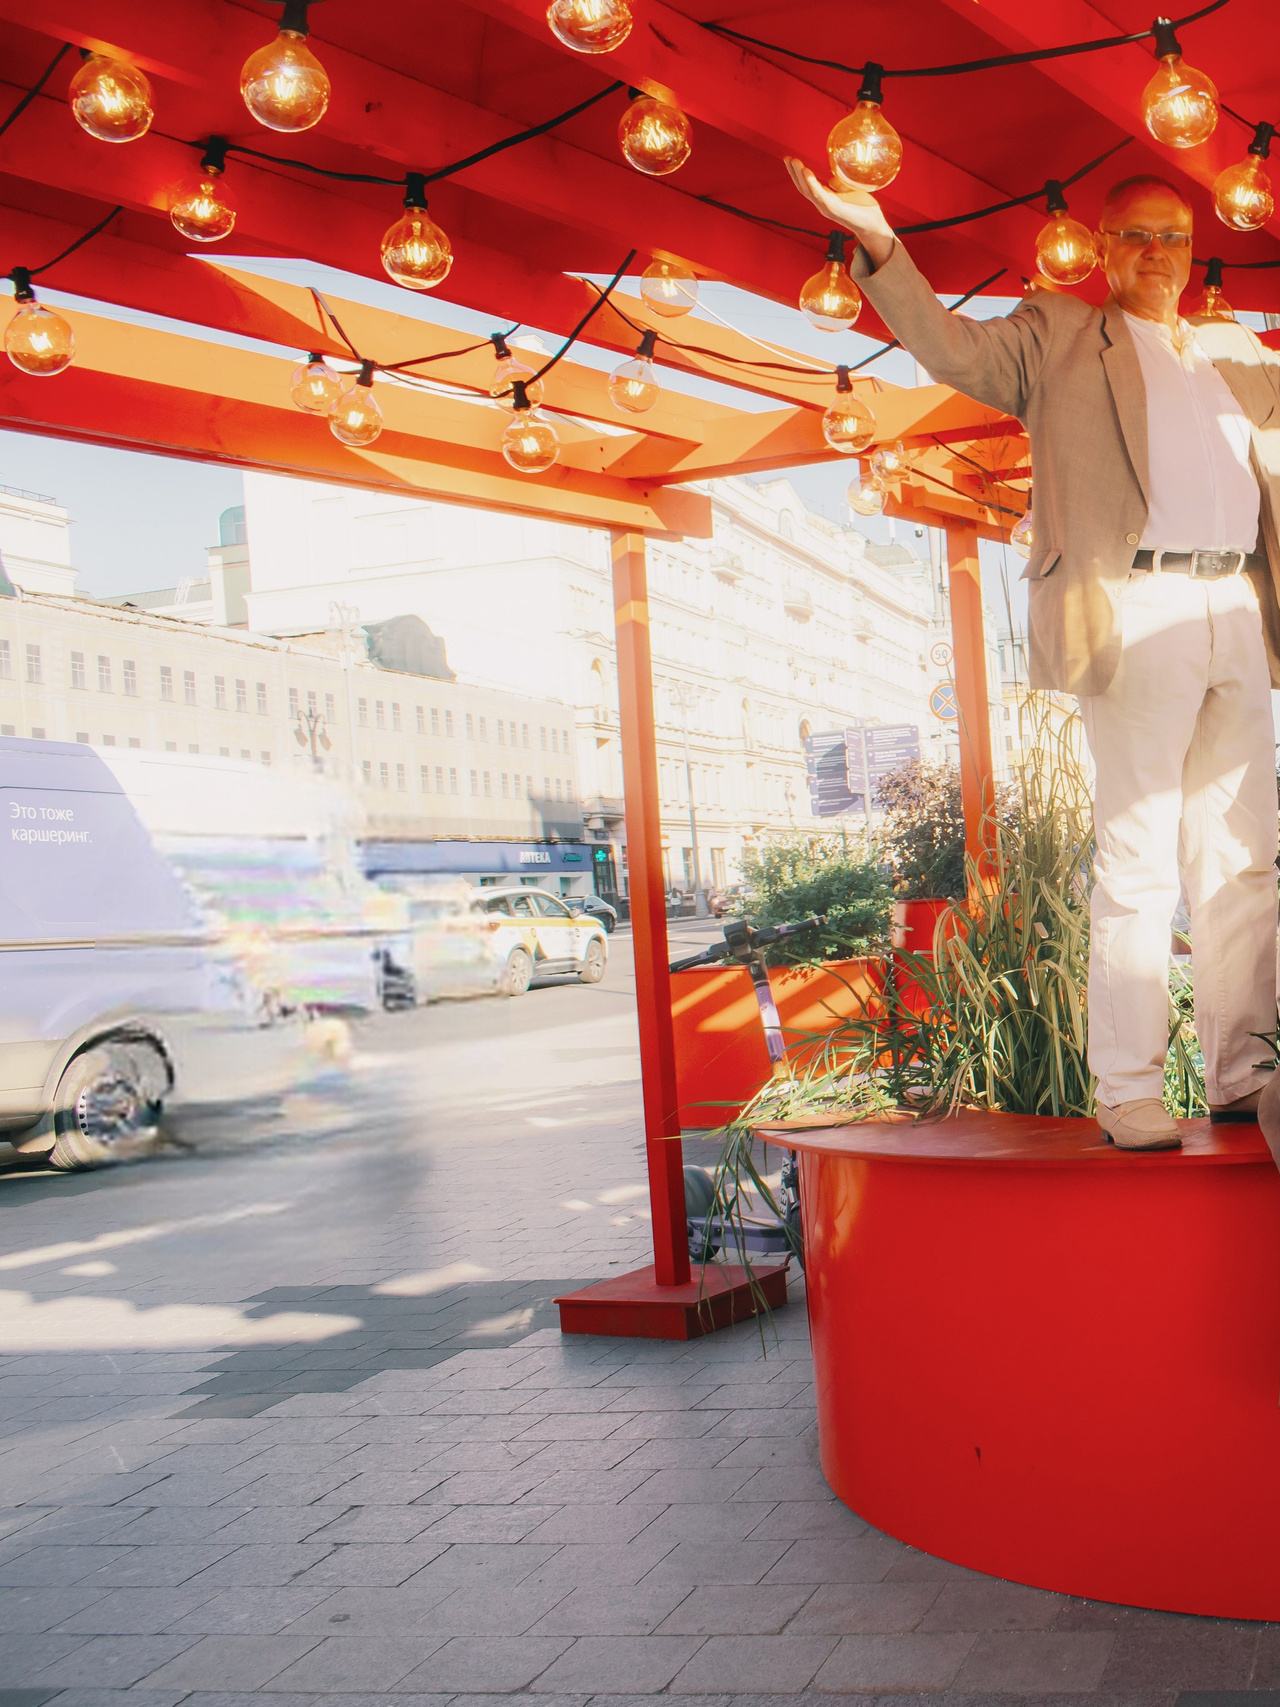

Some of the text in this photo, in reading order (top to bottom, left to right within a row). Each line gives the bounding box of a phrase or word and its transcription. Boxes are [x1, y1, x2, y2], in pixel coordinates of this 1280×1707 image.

[935, 649, 948, 660] 50
[9, 801, 75, 821] Это тоже
[11, 828, 93, 845] каршеринг.
[520, 851, 551, 864] АПТЕКА
